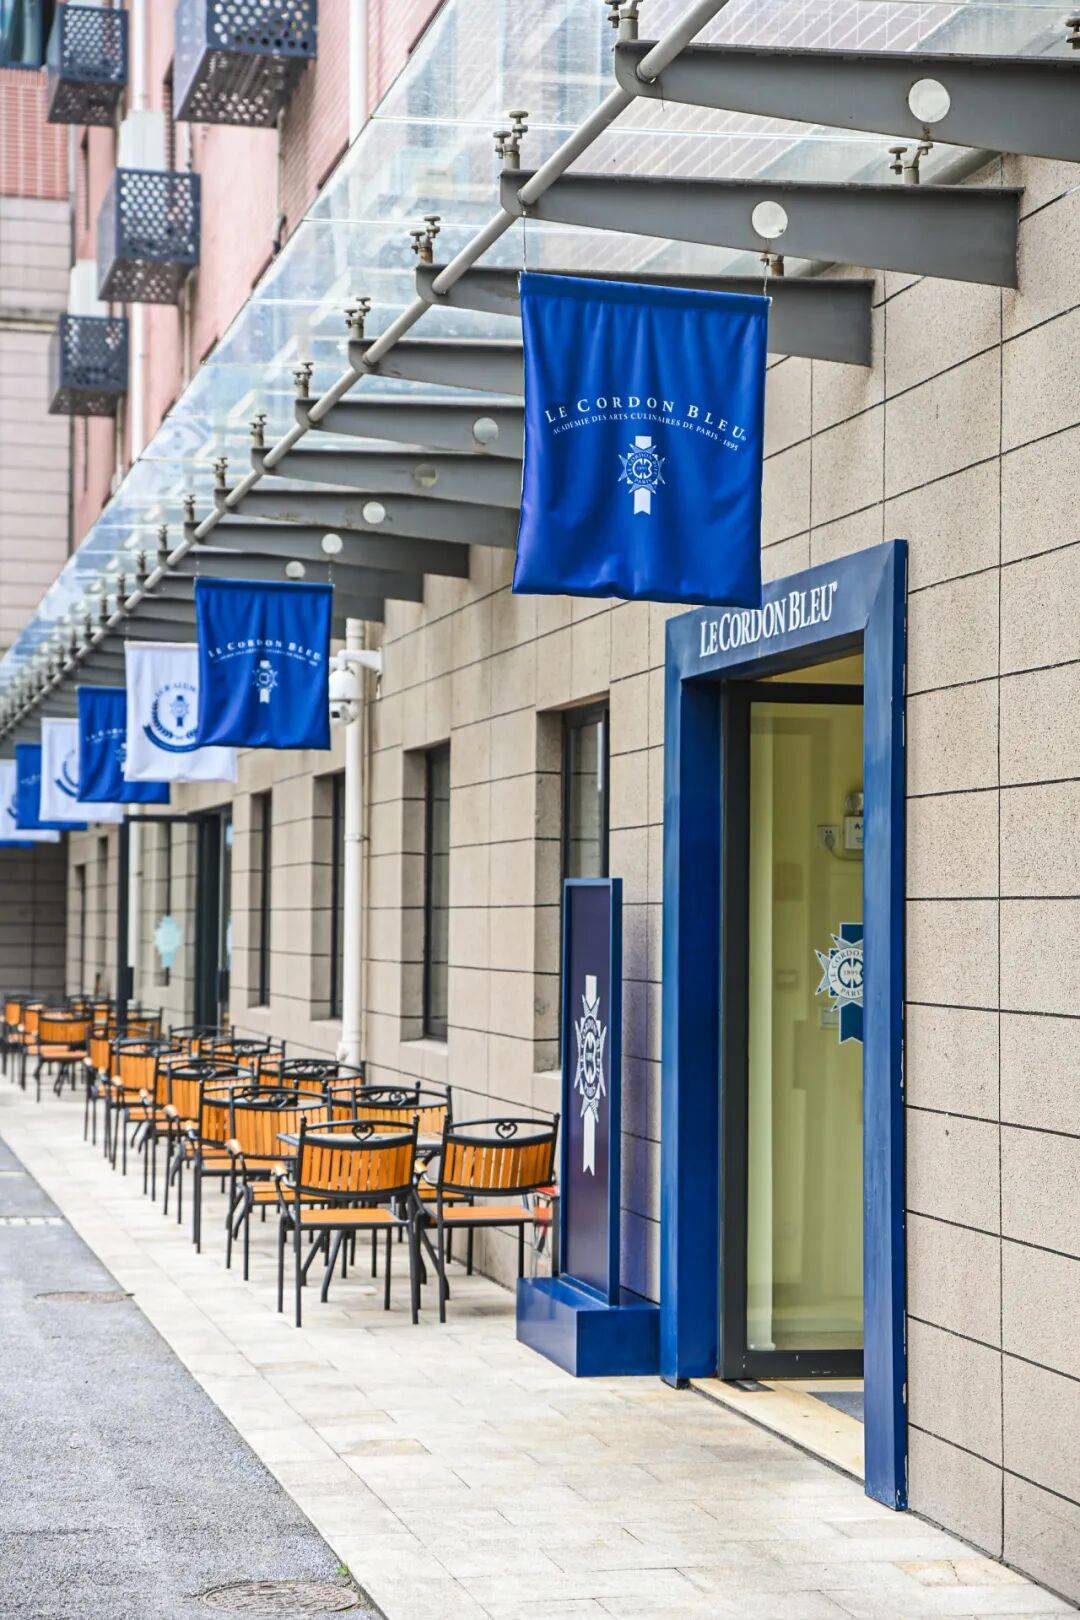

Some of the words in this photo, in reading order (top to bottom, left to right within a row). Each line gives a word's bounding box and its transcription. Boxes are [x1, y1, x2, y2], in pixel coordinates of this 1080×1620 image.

[544, 406, 568, 424] LE
[576, 395, 675, 414] CORDON
[608, 412, 629, 422] ARTS
[630, 411, 681, 427] CULINAIRES
[682, 420, 695, 431] DE
[695, 425, 720, 441] PARIS
[718, 597, 788, 652] CORDON
[226, 638, 282, 651] CORDON
